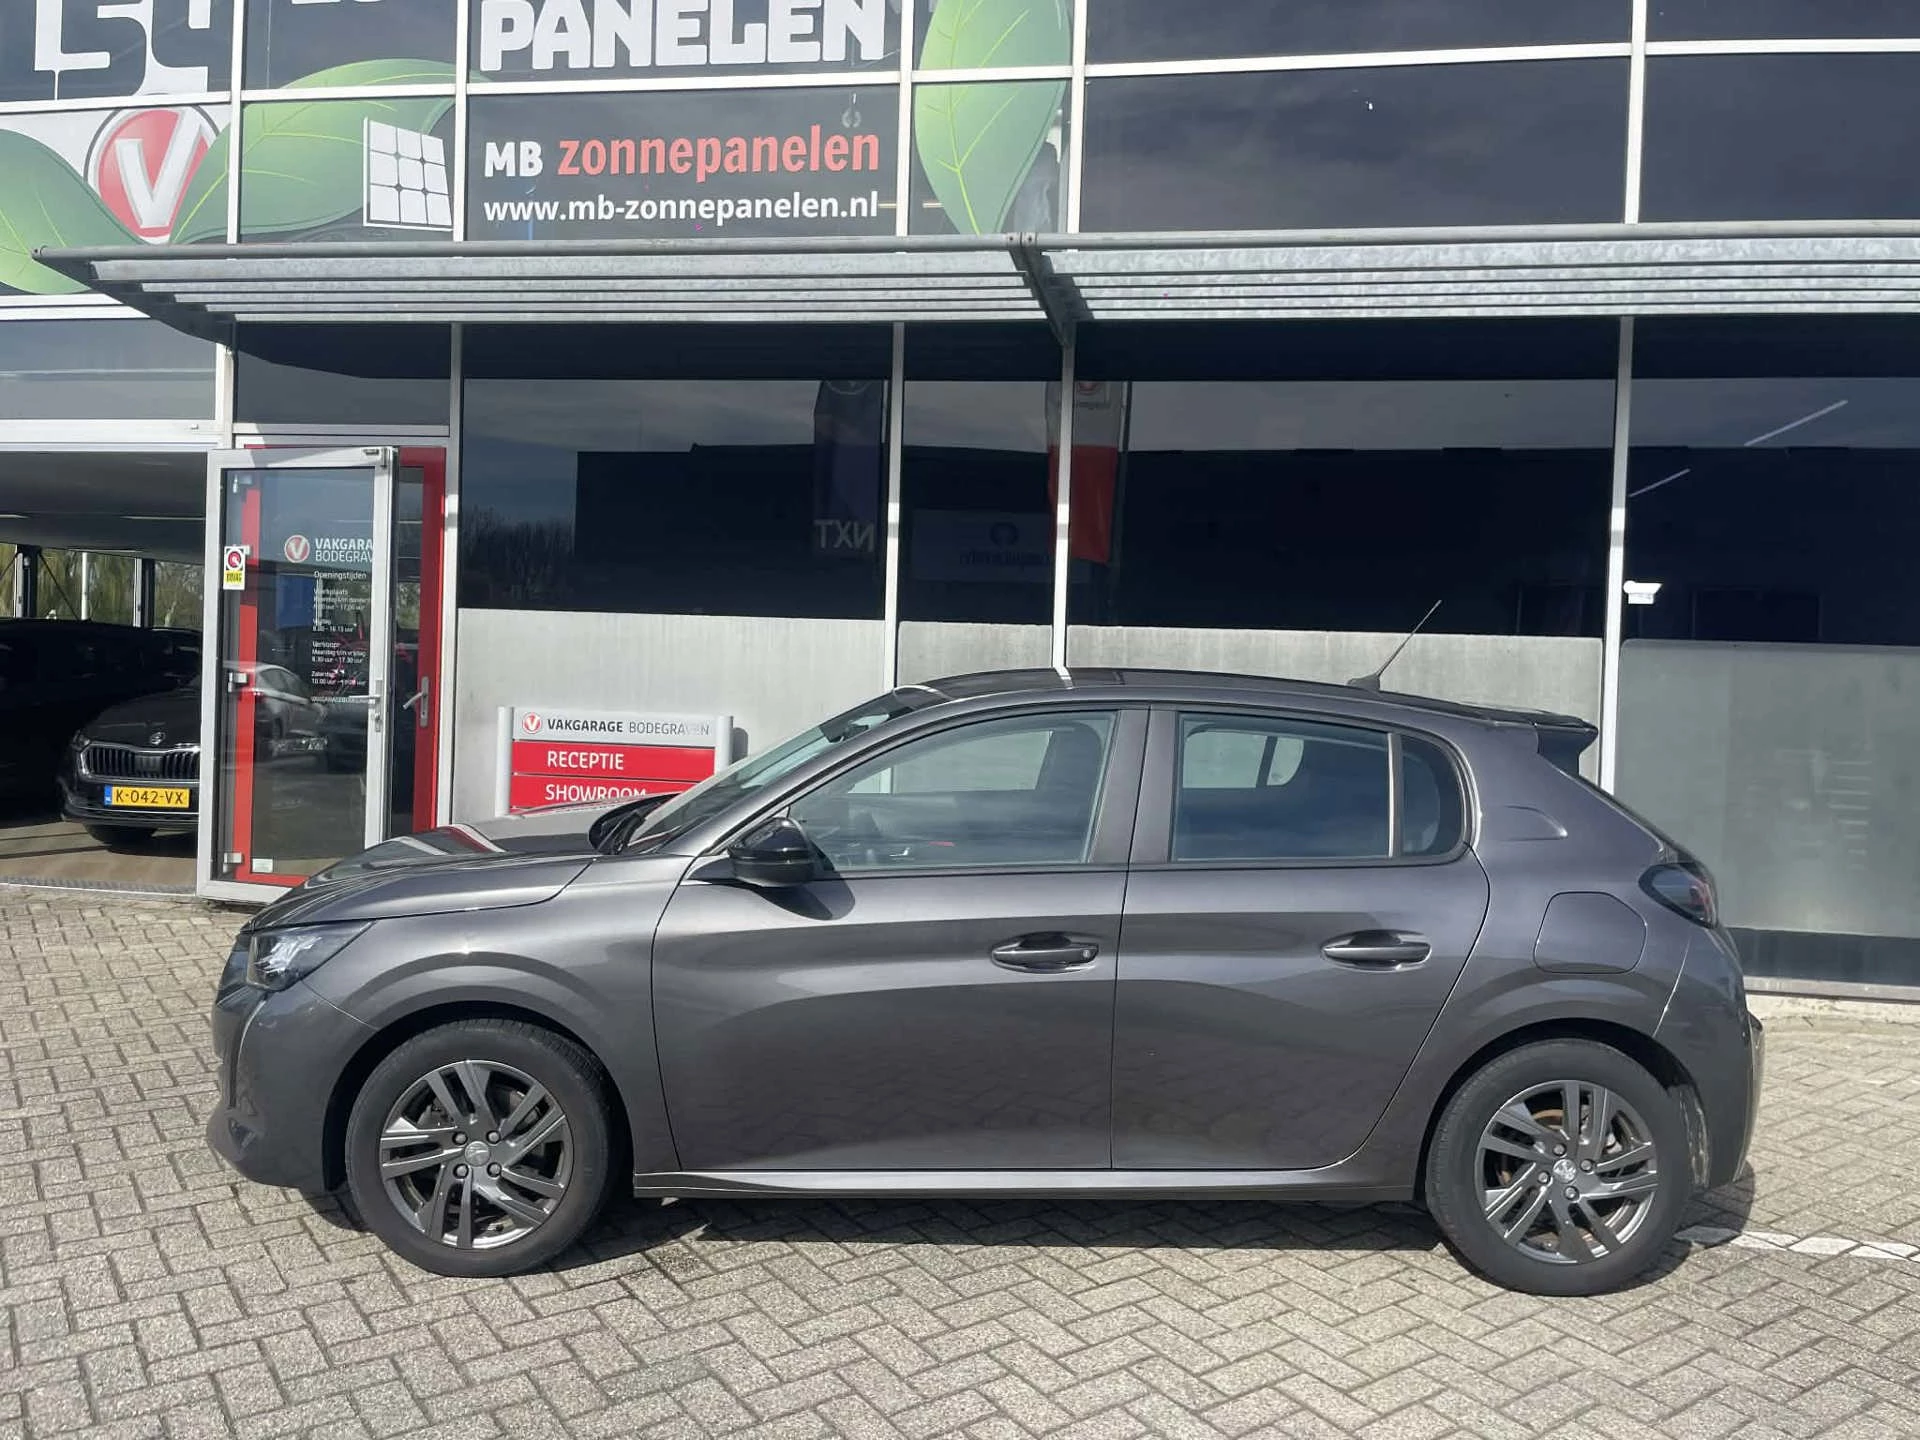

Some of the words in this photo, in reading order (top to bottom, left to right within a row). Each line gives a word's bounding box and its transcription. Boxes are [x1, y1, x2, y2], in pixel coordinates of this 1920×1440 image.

[480, 0, 885, 71] PANELEN
[484, 140, 543, 177] MB
[557, 124, 879, 183] zonnepanelen
[484, 191, 878, 227] www.mb-zonnepanelen.nl
[547, 719, 624, 733] VAKGARAGE
[629, 721, 710, 735] BODEGRAN
[547, 751, 625, 770] RECEPTIE
[116, 788, 184, 805] K-042-VX
